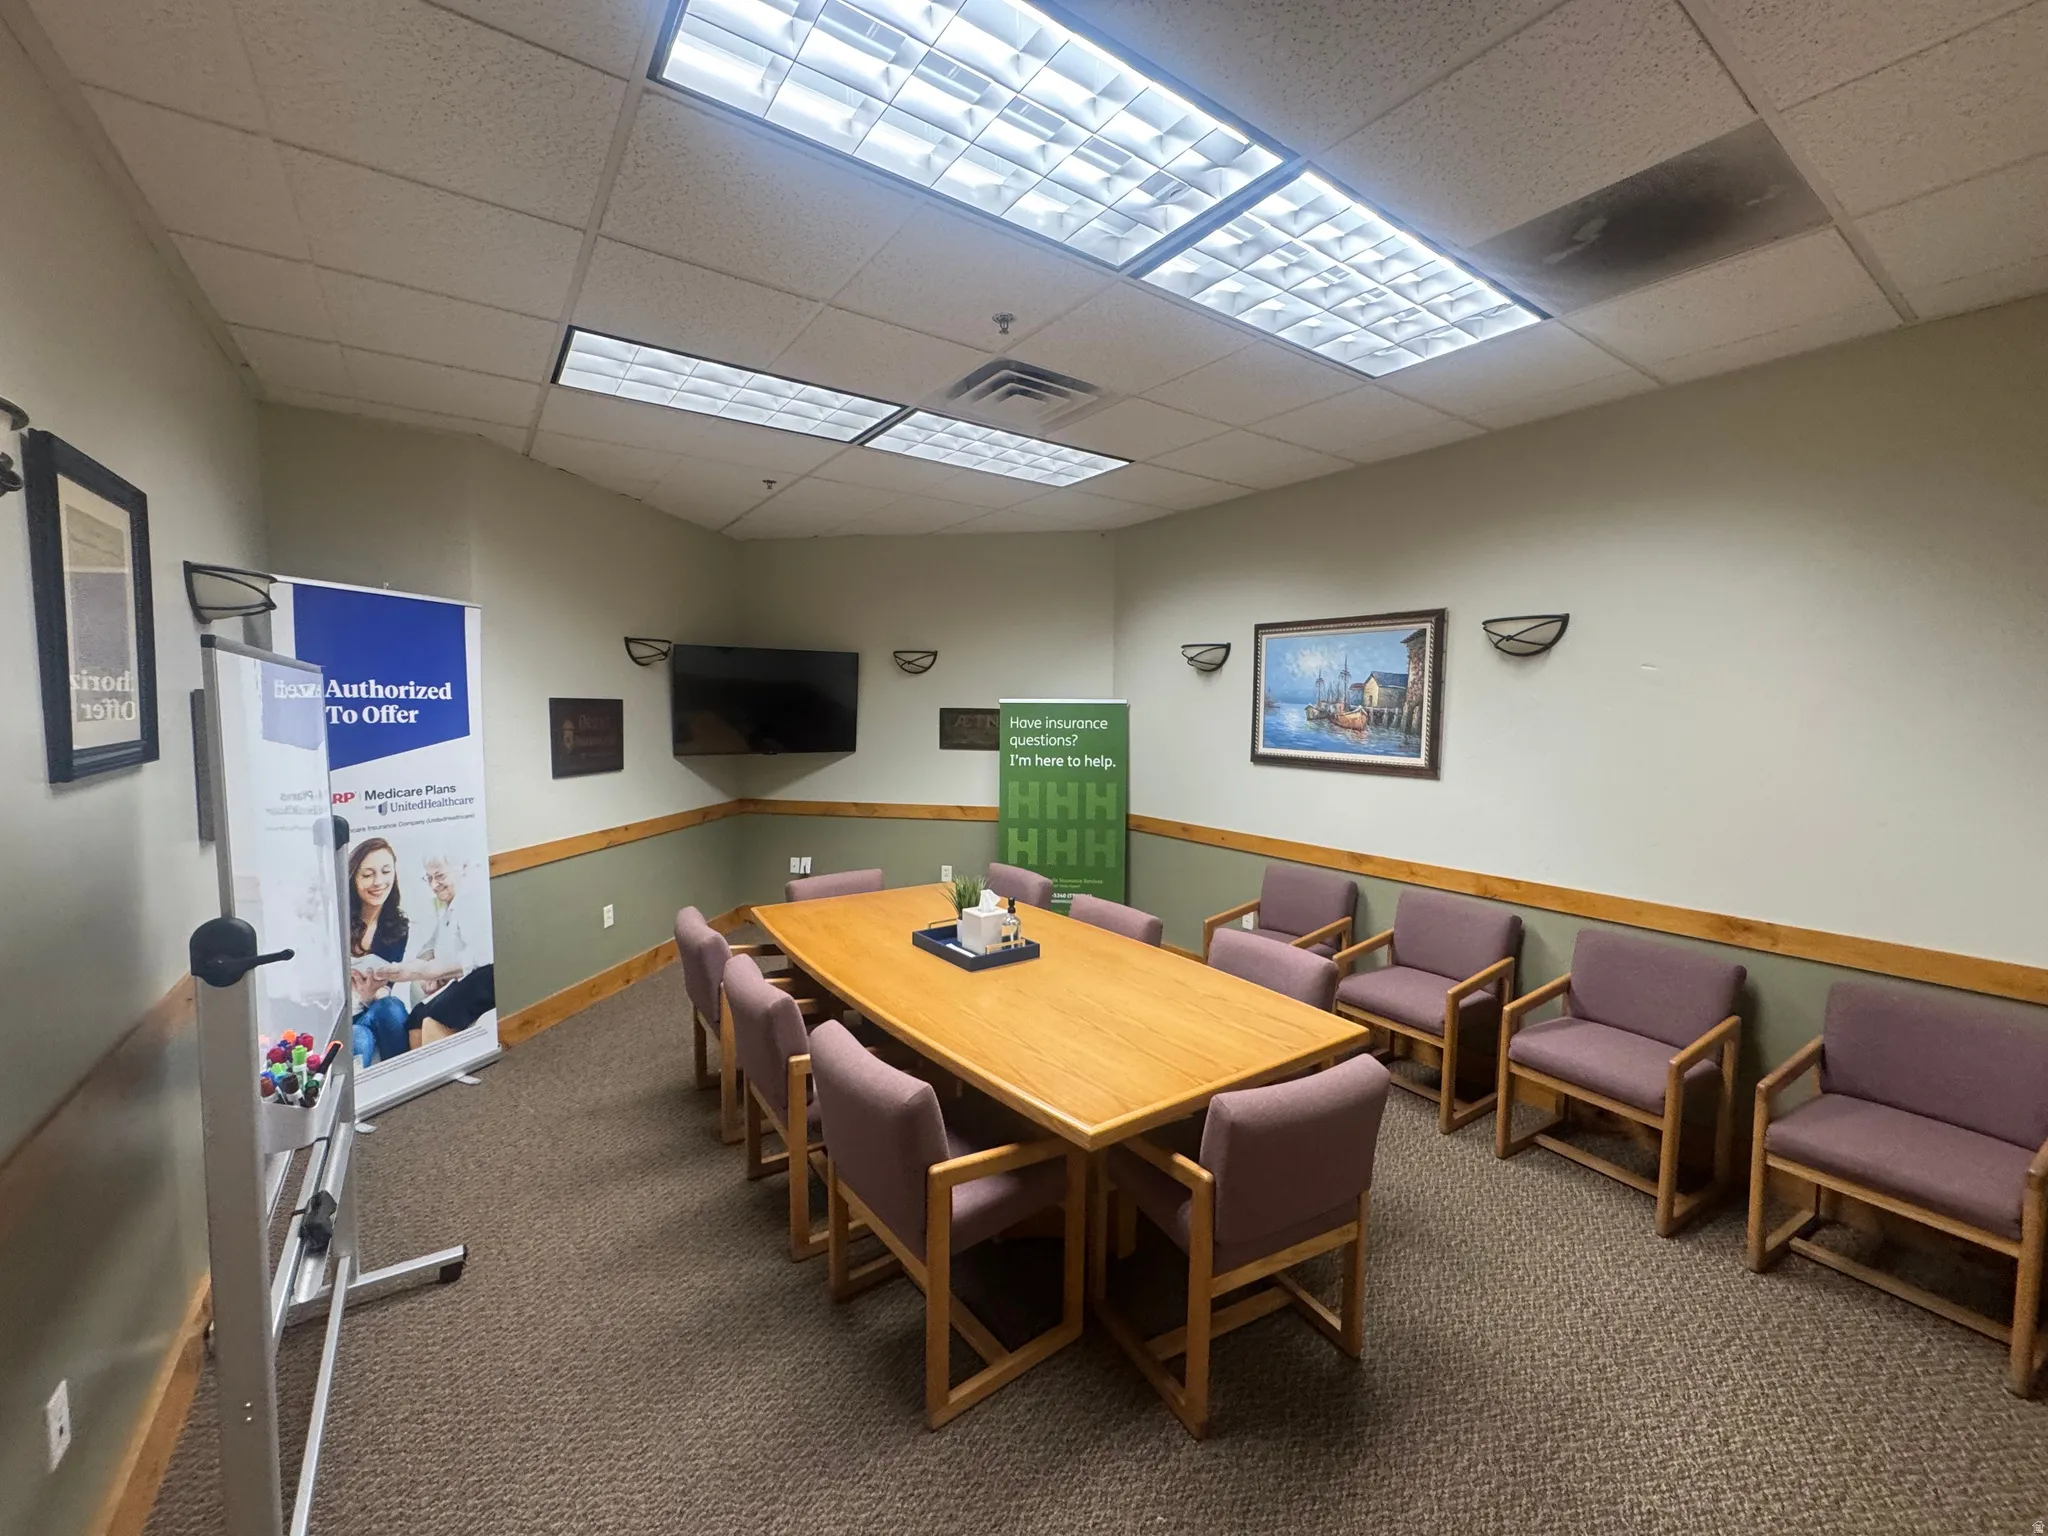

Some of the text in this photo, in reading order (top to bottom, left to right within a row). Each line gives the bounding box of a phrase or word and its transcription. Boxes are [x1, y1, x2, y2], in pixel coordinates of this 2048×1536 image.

[325, 679, 453, 700] Authorized
[325, 704, 419, 724] To Offer
[1009, 716, 1108, 730] Have insurance
[1009, 733, 1078, 749] questions?
[1035, 754, 1064, 767] here
[1067, 755, 1081, 768] to
[1084, 754, 1116, 771] help.
[331, 785, 456, 804] RP Medicare Plans
[390, 796, 475, 814] UnitedHealthcare
[398, 818, 426, 828] Company
